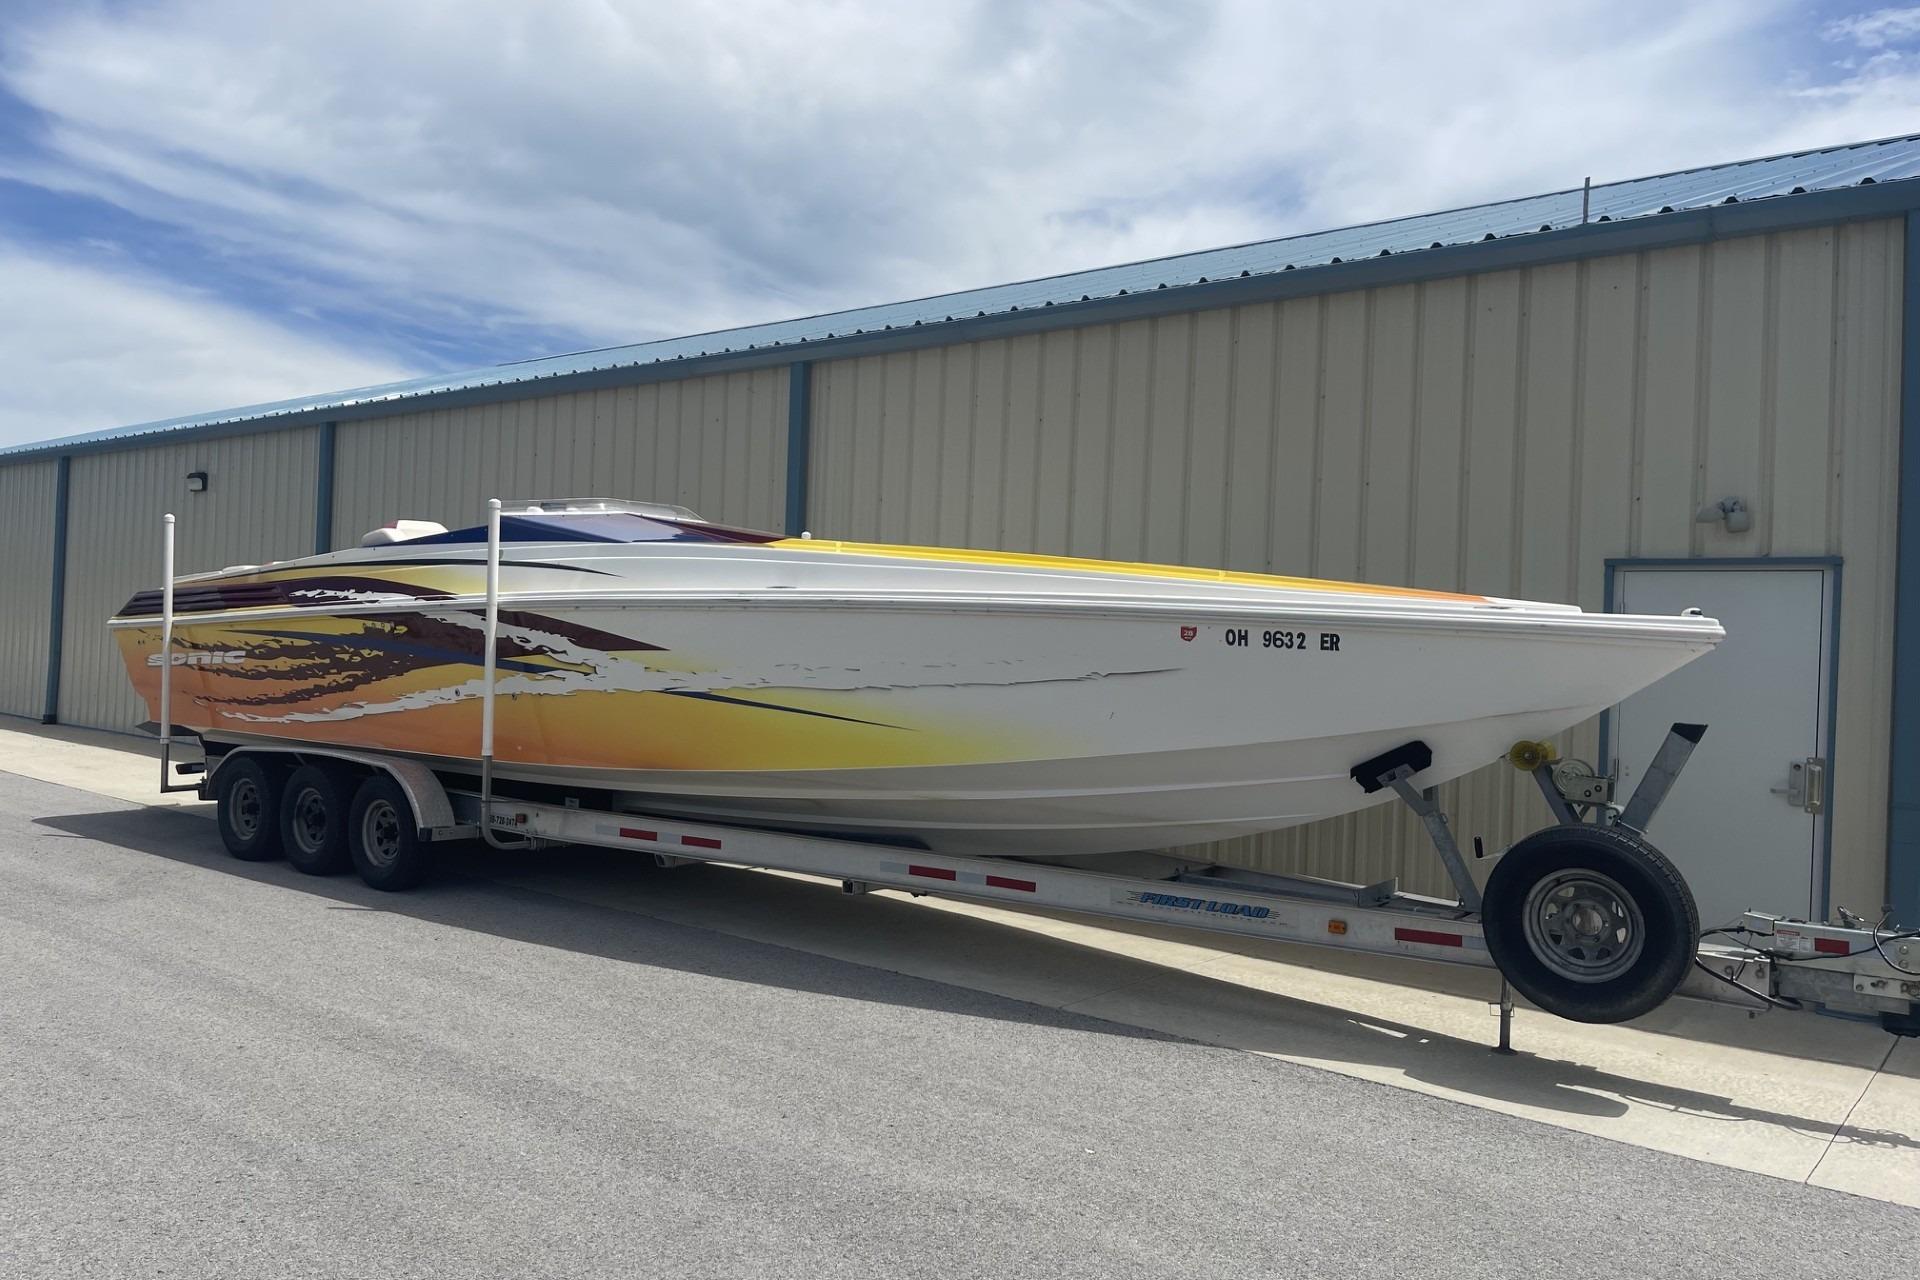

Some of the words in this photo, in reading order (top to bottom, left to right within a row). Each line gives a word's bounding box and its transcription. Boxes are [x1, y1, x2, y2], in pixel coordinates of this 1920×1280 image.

[1225, 629, 1248, 647] OH
[1262, 630, 1306, 650] 9632
[1320, 633, 1340, 651] ER
[1140, 892, 1204, 909] FIRST
[1206, 901, 1270, 918] LOAD
